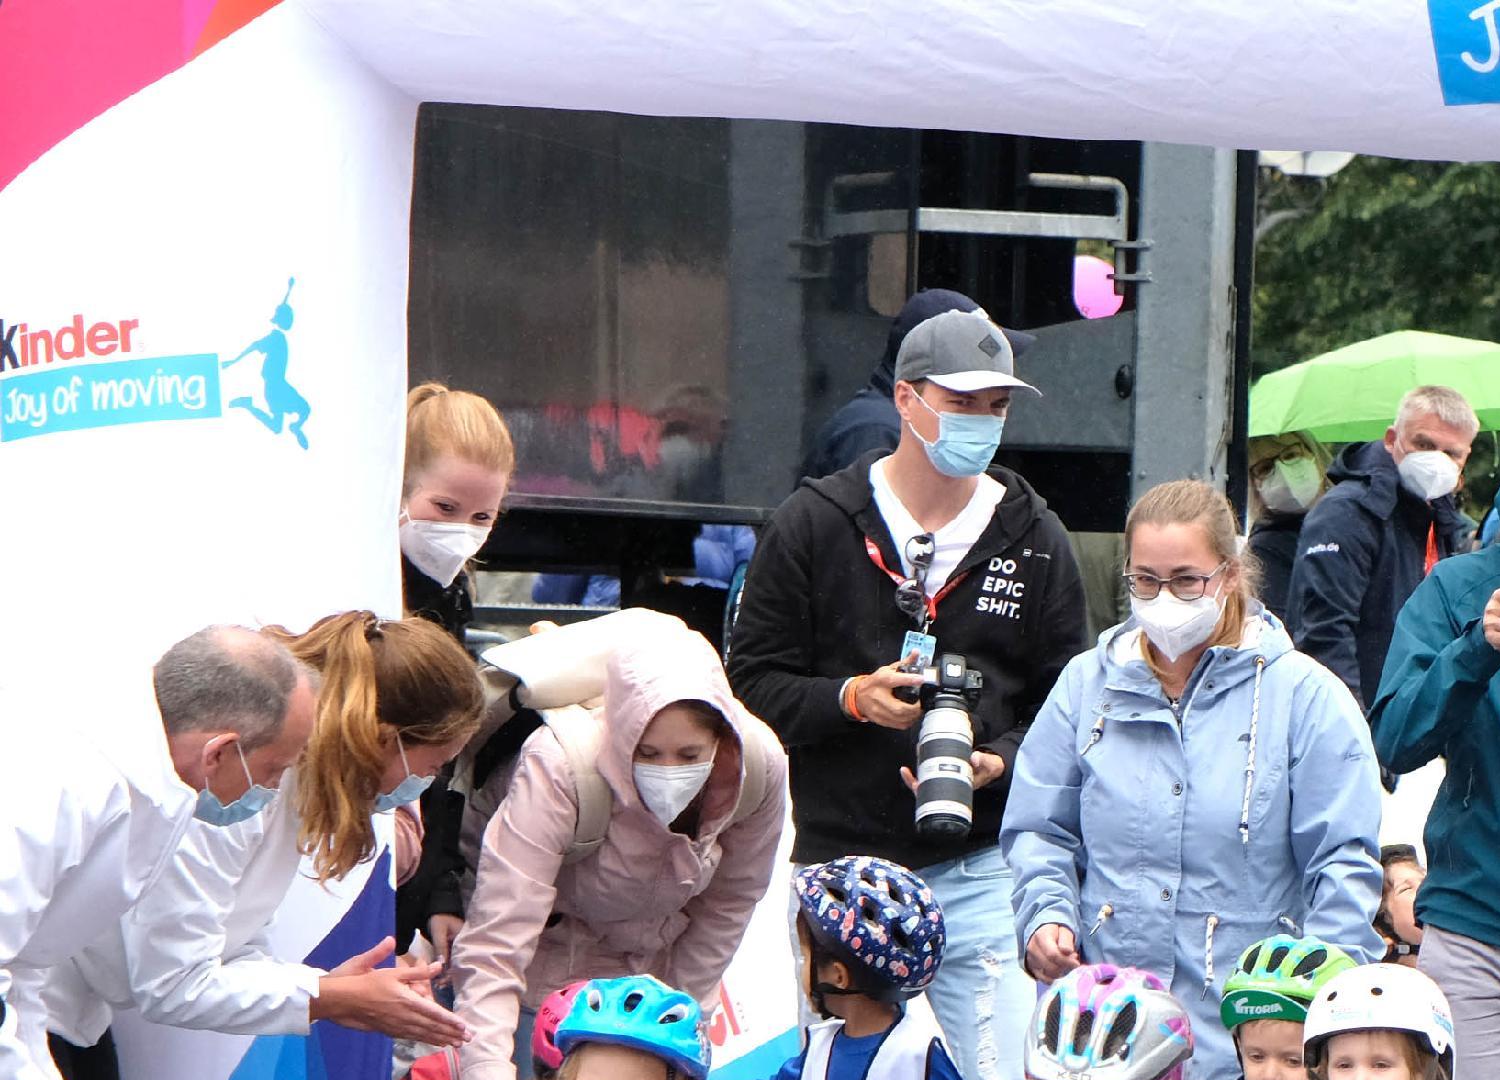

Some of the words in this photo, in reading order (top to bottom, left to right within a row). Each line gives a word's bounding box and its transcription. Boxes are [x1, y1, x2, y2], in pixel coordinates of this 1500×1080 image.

[5, 387, 47, 427] Joy
[53, 375, 83, 414] of
[92, 368, 207, 410] moving
[988, 557, 1017, 575] DO
[982, 575, 1025, 598] EPIC
[976, 596, 1021, 619] SHIT.
